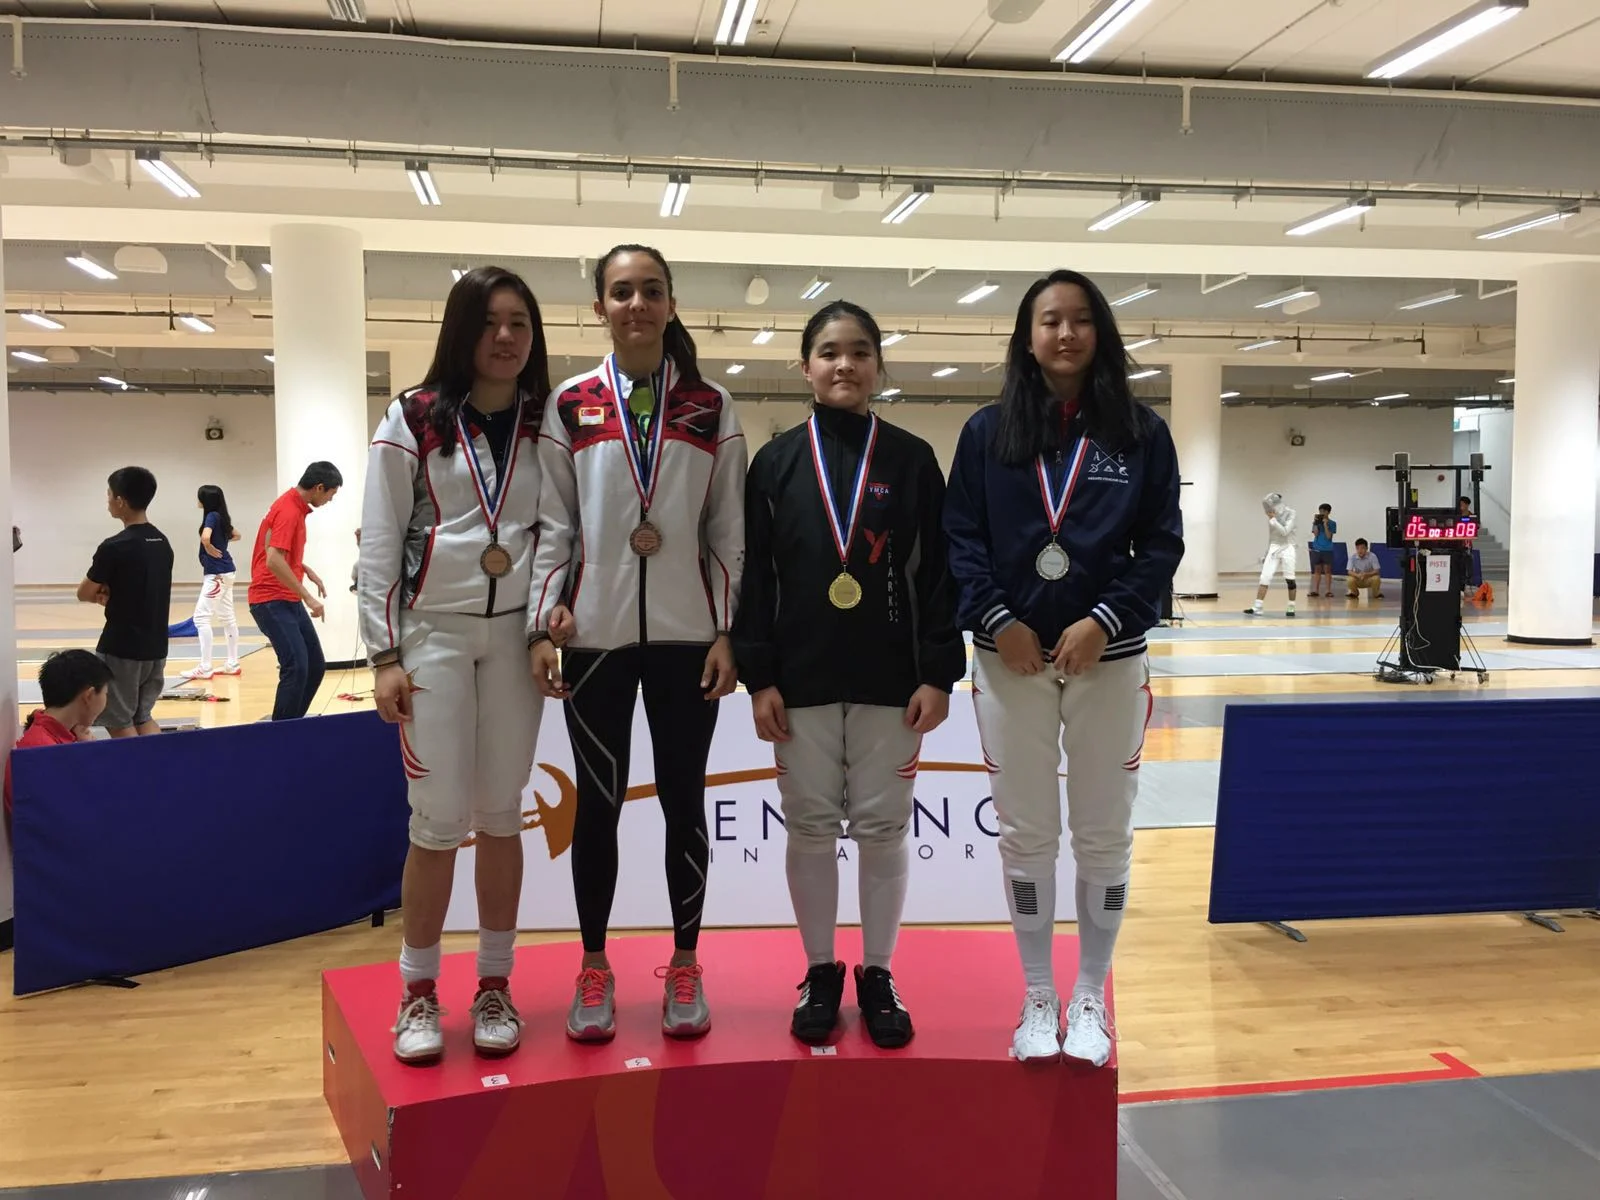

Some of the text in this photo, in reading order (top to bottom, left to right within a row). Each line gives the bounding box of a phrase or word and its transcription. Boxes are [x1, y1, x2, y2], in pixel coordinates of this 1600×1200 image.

[1406, 523, 1427, 537] 05
[1455, 522, 1476, 537] 08
[1429, 560, 1448, 568] PISTE
[1435, 574, 1441, 583] 3
